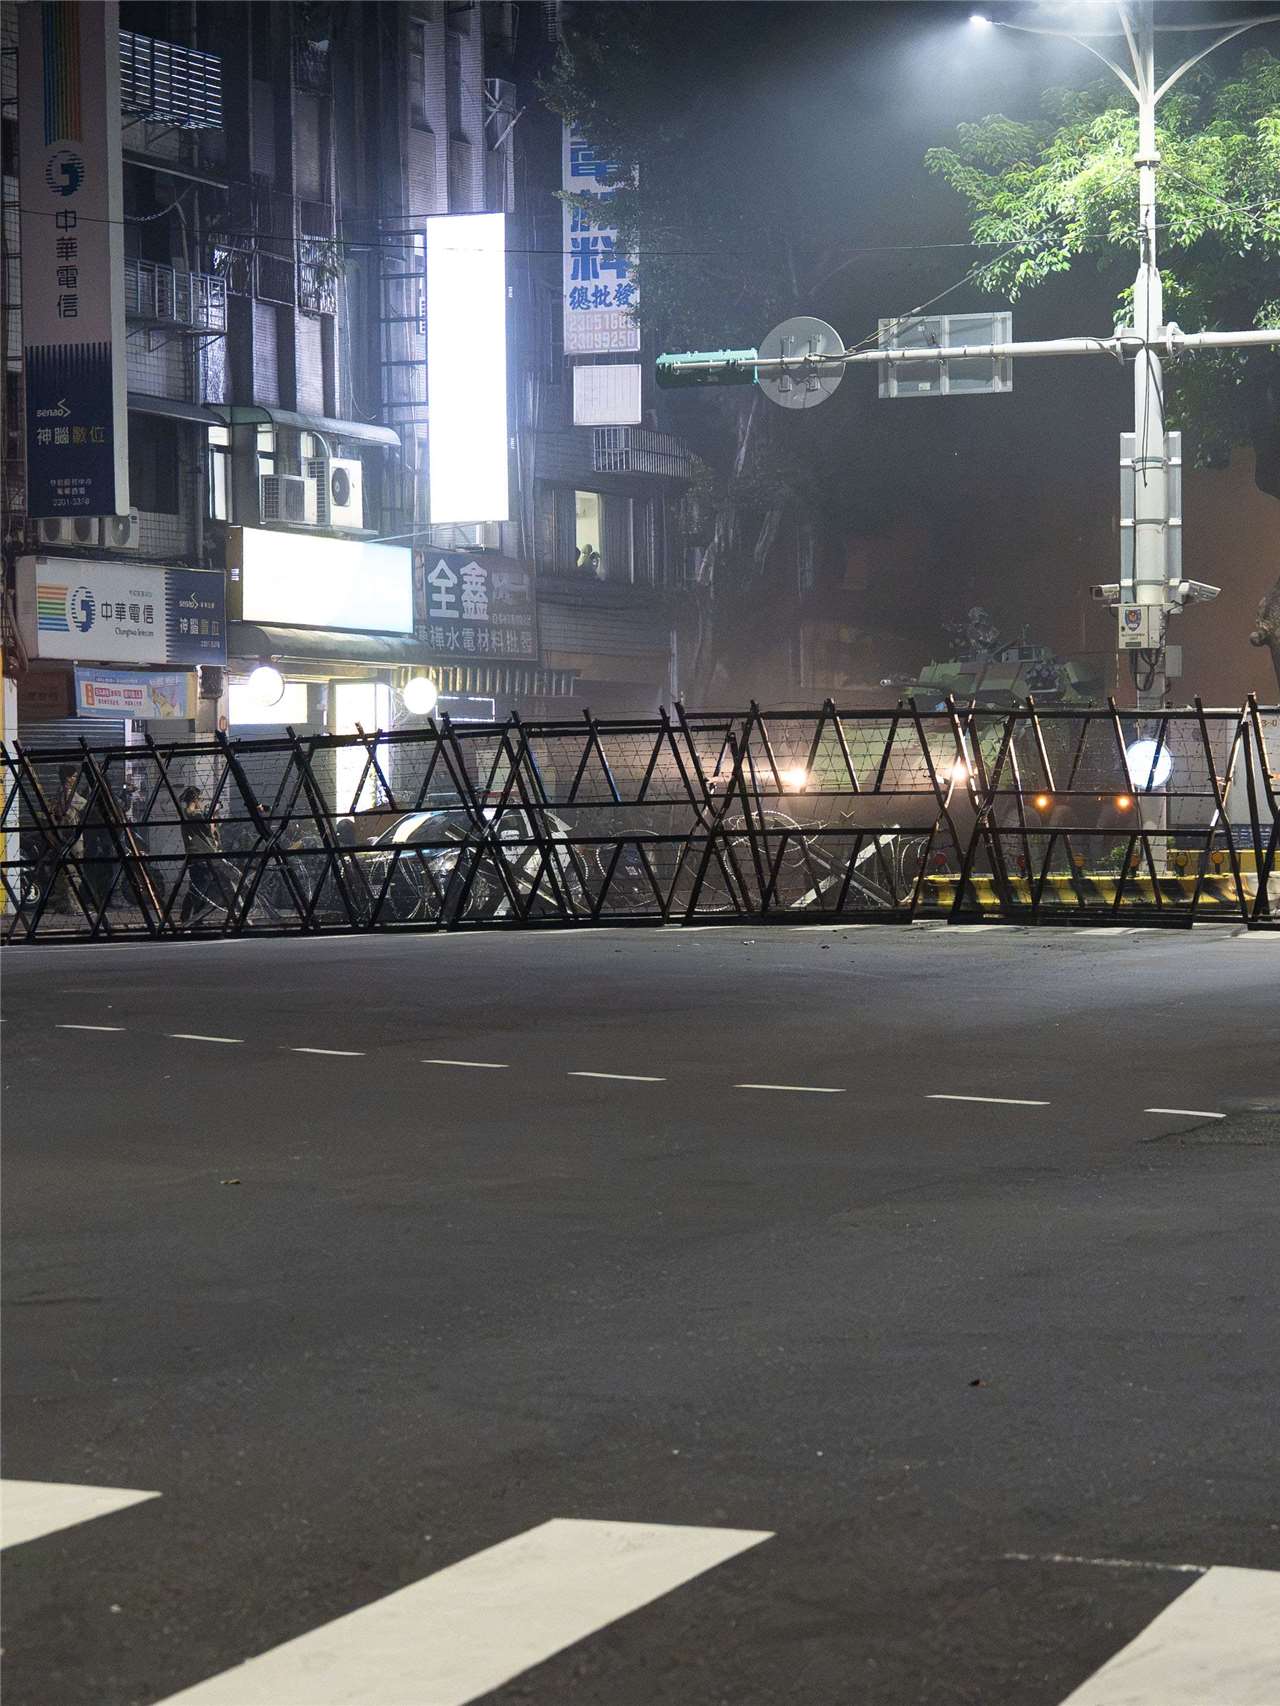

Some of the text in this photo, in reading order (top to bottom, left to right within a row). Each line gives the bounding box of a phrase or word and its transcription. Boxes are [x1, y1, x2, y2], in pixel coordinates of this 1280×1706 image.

[55, 208, 79, 319] 中華電信
[569, 282, 636, 311] 總批發
[101, 601, 154, 624] 中華電信
[427, 558, 490, 621] 全鑫
